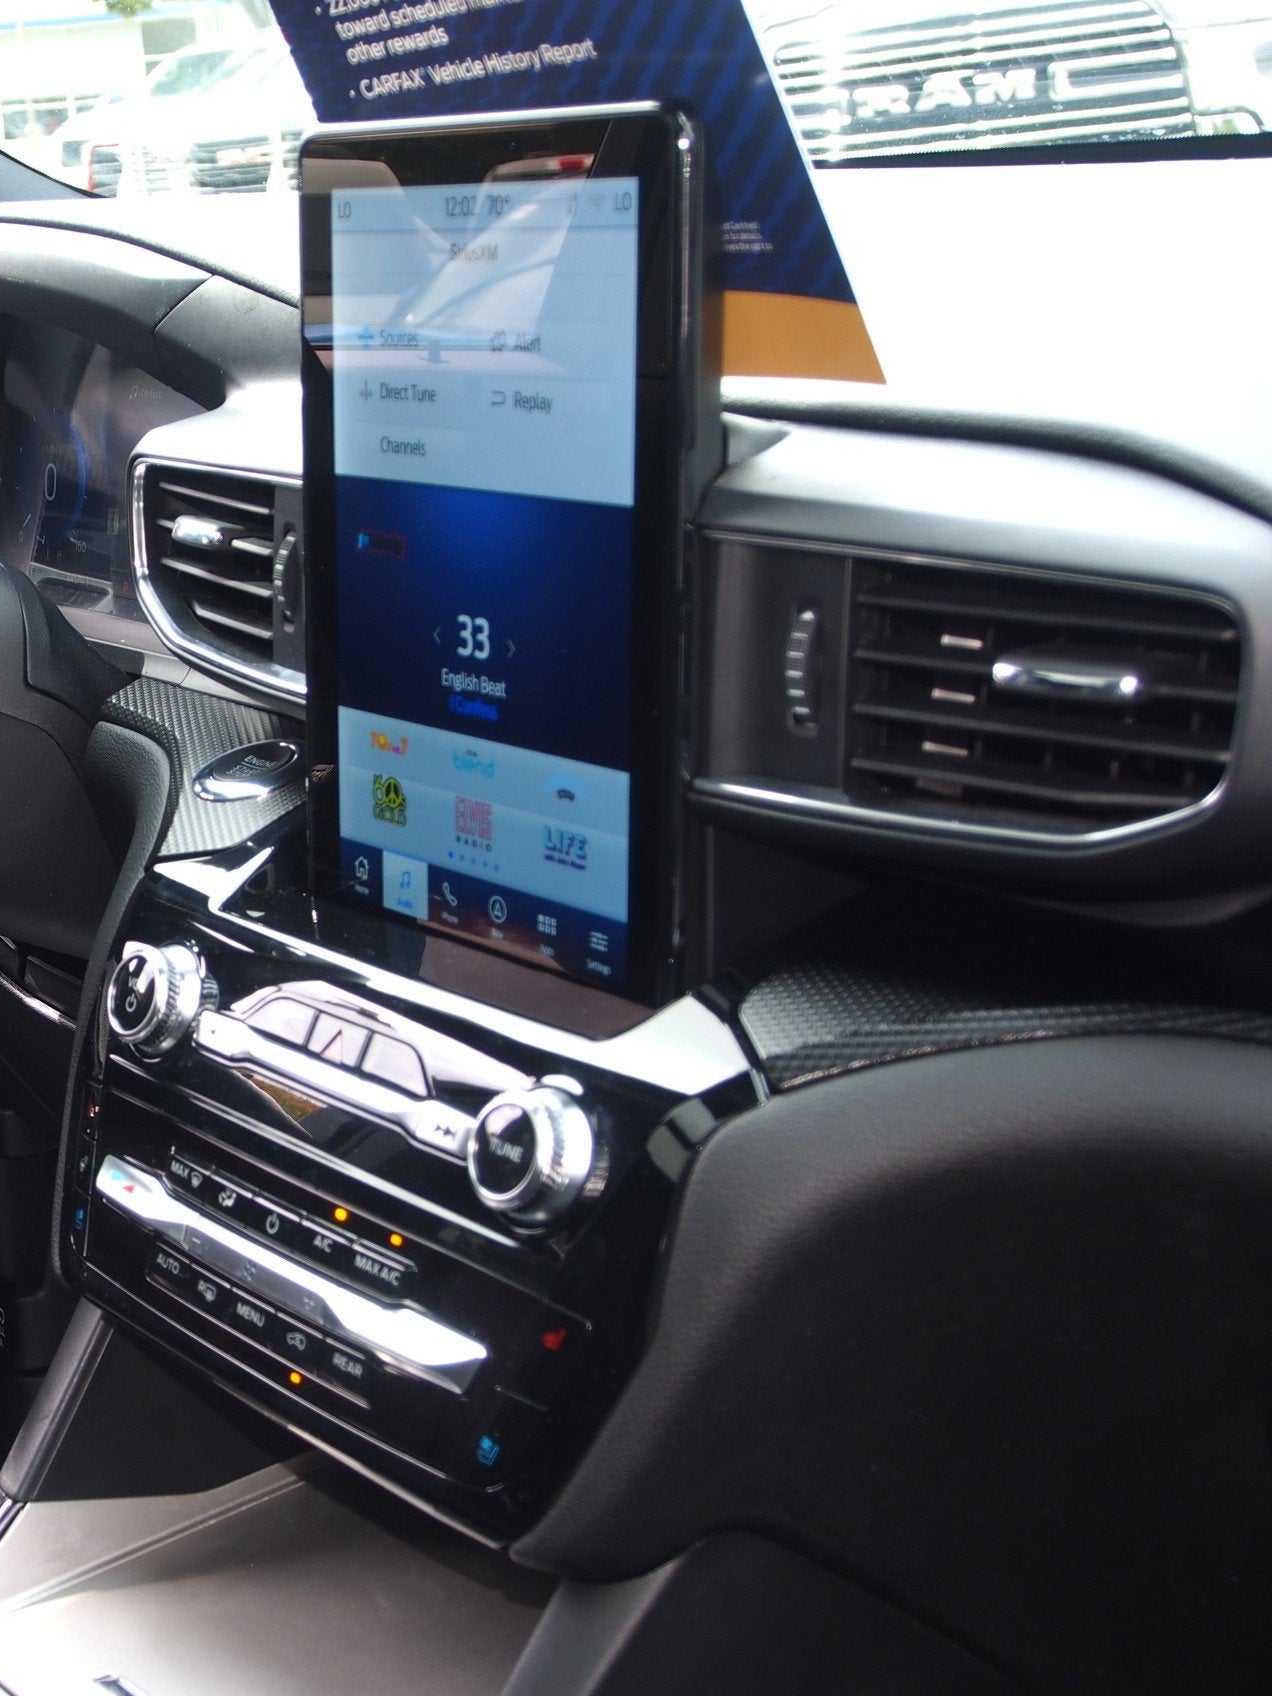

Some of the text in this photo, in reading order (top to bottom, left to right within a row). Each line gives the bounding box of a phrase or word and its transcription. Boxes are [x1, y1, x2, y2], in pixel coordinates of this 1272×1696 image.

[335, 0, 467, 41] toward scheduled
[345, 24, 450, 65] other rewards
[427, 56, 486, 87] Vehicle
[485, 47, 541, 74] History
[539, 37, 598, 66] Report
[852, 68, 1036, 118] RAM
[338, 201, 352, 218] LO
[444, 195, 478, 217] 12:02
[614, 192, 632, 212] LO
[380, 329, 419, 349] Sources
[380, 382, 437, 404] Direct Tune
[513, 391, 554, 414] Replay
[380, 432, 428, 457] Channels
[44, 462, 57, 501] 0
[456, 614, 491, 660] 33
[441, 668, 507, 699] English Beat
[455, 834, 494, 852] RADIO
[544, 824, 588, 860] LIFE
[488, 1135, 525, 1164] TUNE
[170, 1160, 191, 1180] MAX
[312, 1233, 334, 1254] A/C
[155, 1252, 180, 1276] AUTO
[353, 1252, 402, 1287] MAX A/C
[235, 1301, 266, 1328] MENU
[331, 1351, 364, 1380] REAR
